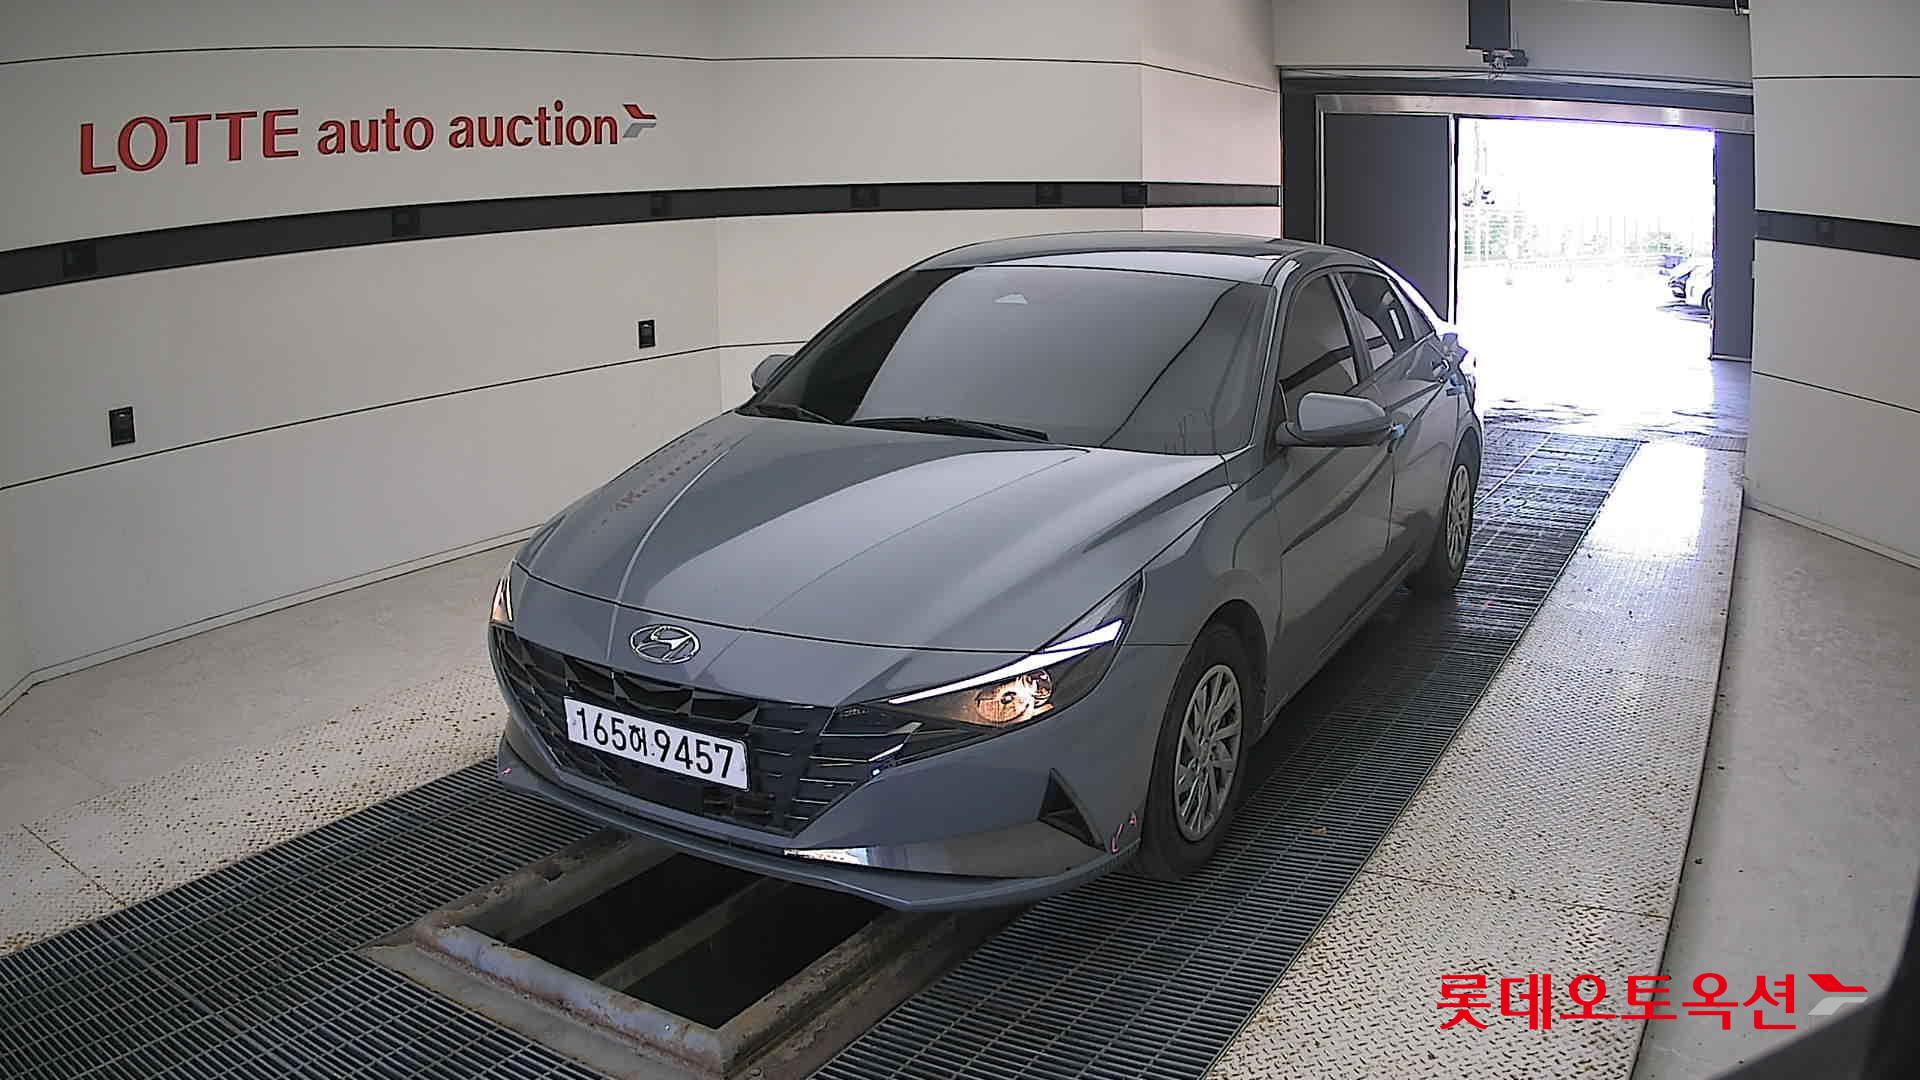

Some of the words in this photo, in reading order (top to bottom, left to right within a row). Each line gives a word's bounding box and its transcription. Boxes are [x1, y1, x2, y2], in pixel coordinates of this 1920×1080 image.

[80, 109, 298, 175] LOTTE
[317, 108, 434, 155] auto
[448, 100, 618, 149] auction
